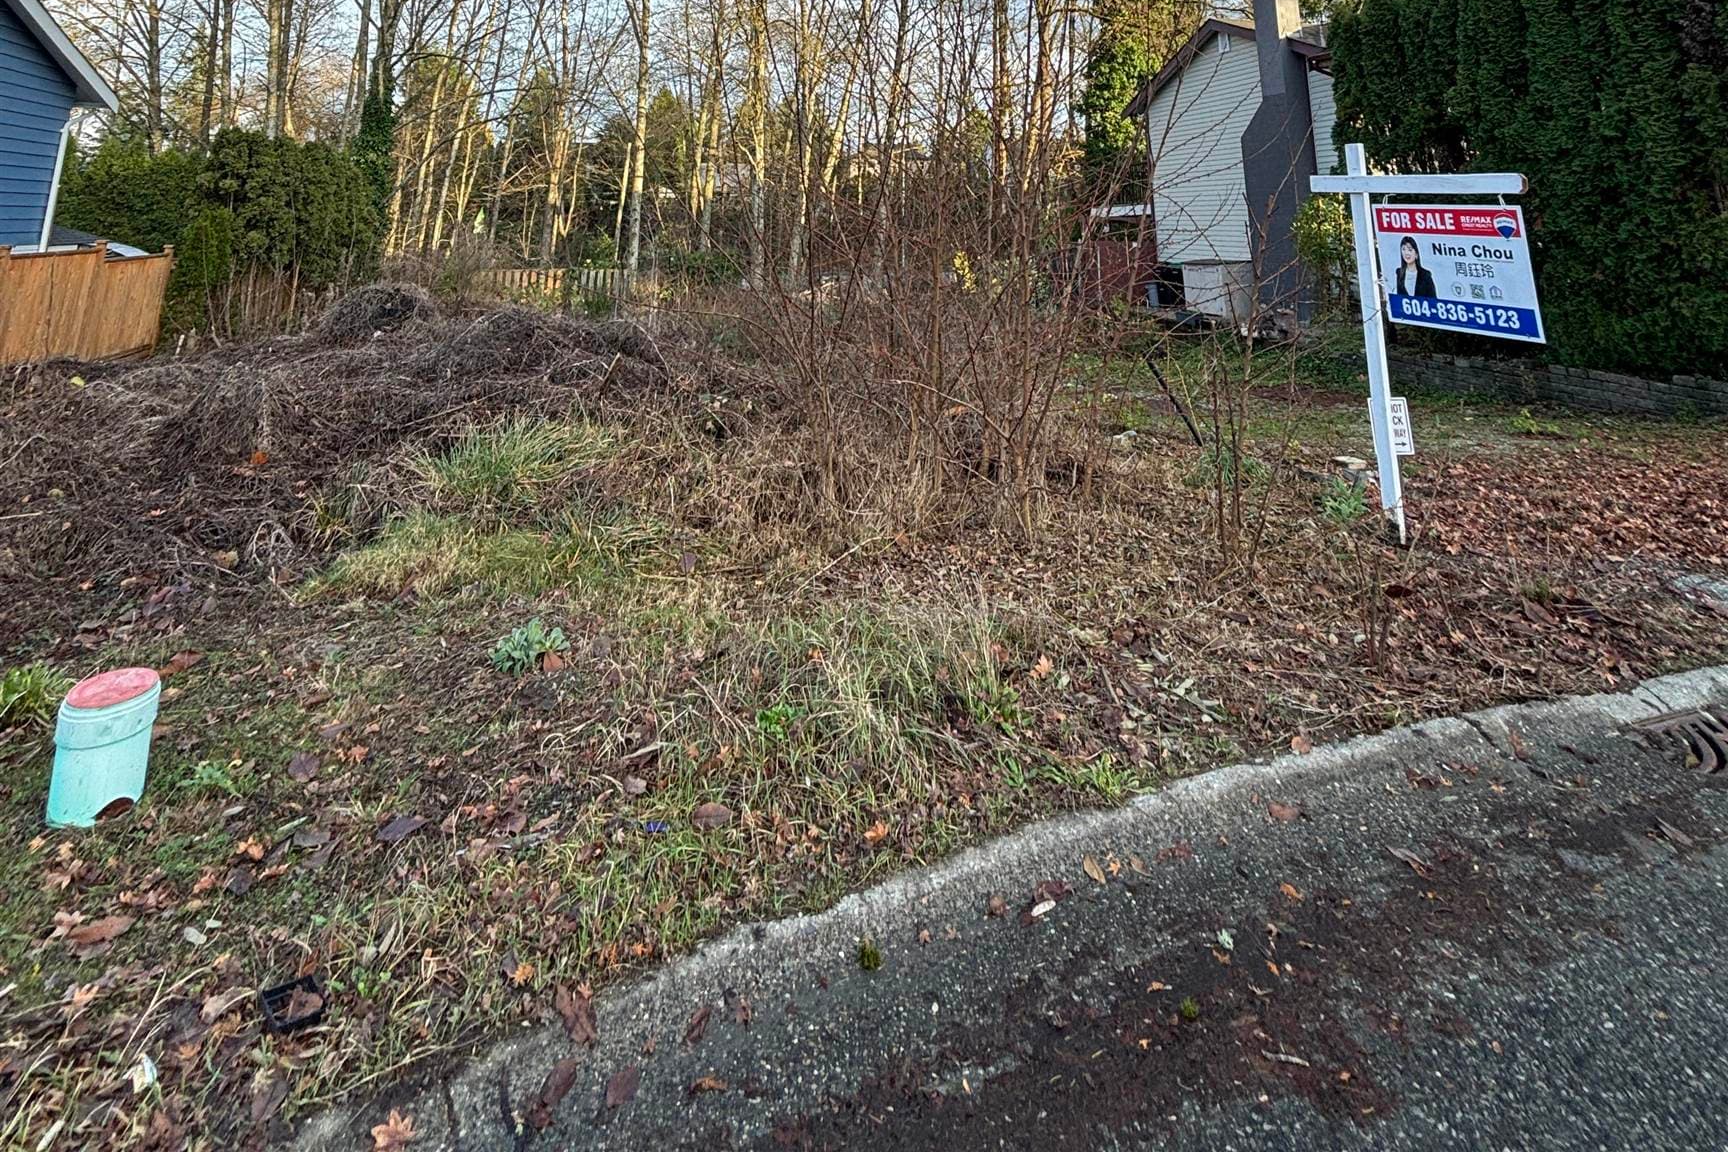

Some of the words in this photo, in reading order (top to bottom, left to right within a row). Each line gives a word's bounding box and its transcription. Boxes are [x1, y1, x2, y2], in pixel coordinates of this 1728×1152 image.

[1381, 212, 1412, 229] FOR
[1415, 212, 1456, 230] SALE
[1460, 215, 1492, 224] RE/MAX
[1431, 242, 1467, 257] Nina
[1471, 244, 1514, 260] Chou
[1401, 298, 1520, 329] 604-836-5123
[1392, 415, 1404, 426] CK
